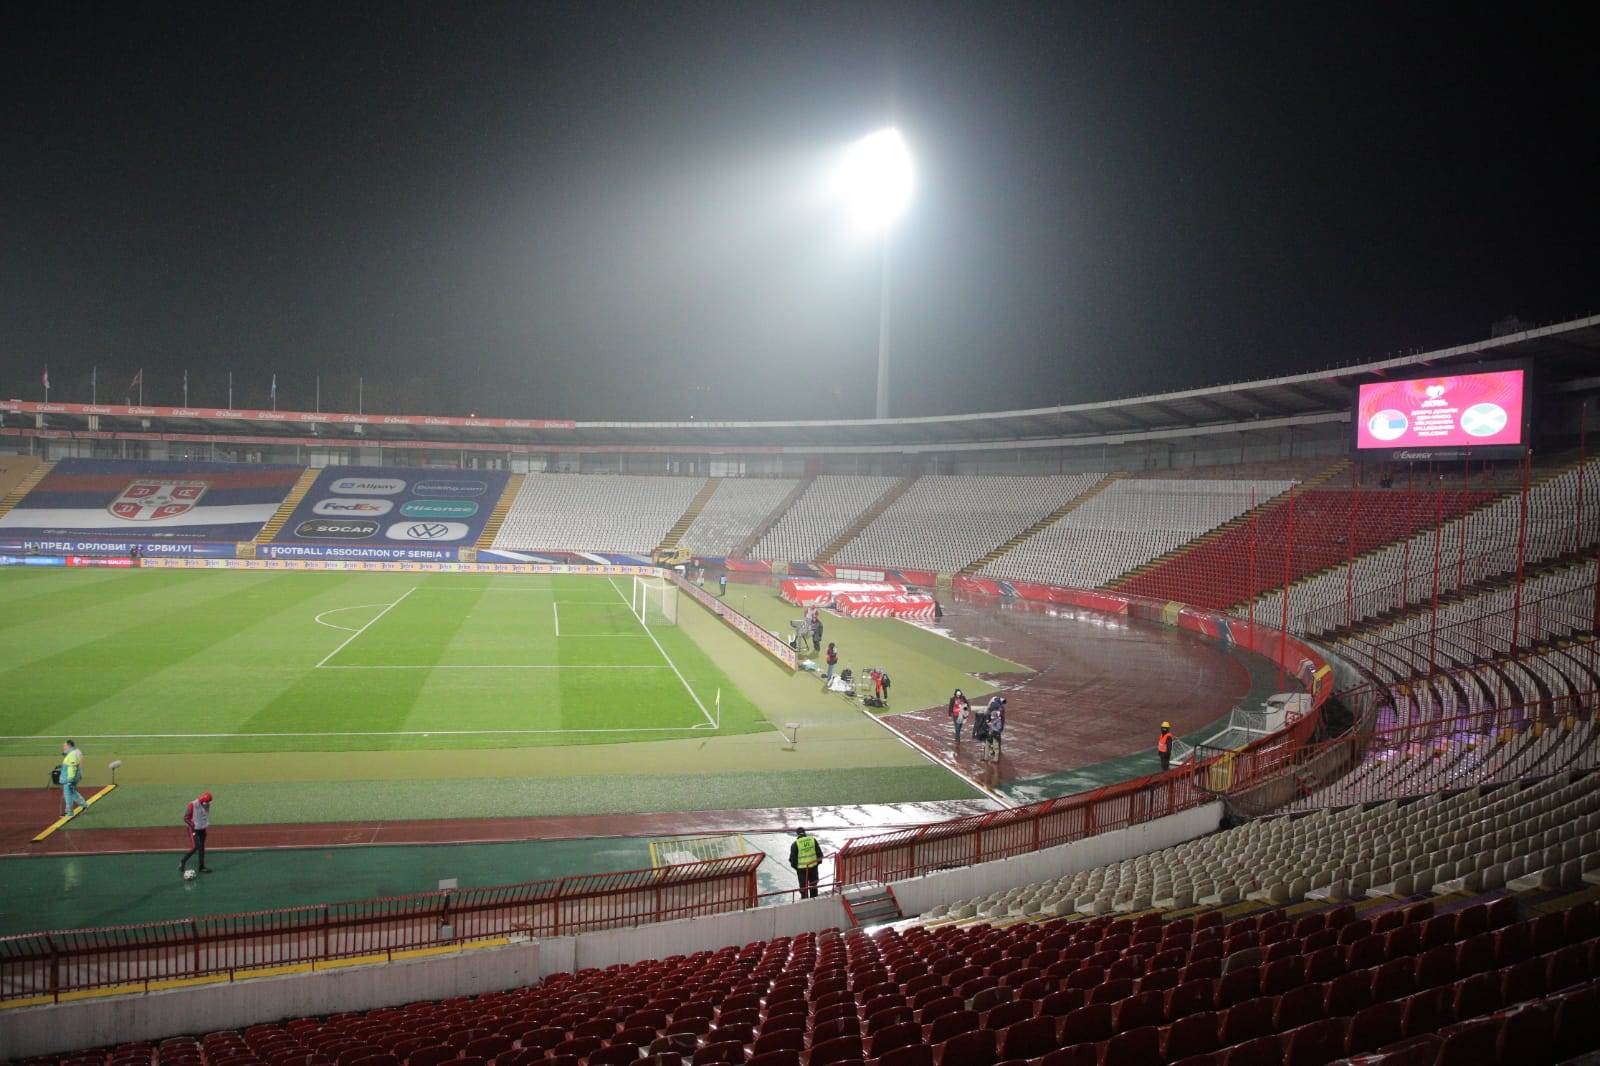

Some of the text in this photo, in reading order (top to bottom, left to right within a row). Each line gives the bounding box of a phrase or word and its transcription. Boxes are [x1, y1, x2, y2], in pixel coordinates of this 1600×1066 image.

[323, 502, 382, 511] FedEx
[78, 542, 126, 551] ОРЛОВИ!
[147, 544, 192, 552] СРБИЈУ!
[272, 546, 442, 558] FOOTBALL ASSOCIATION OF SERBIA
